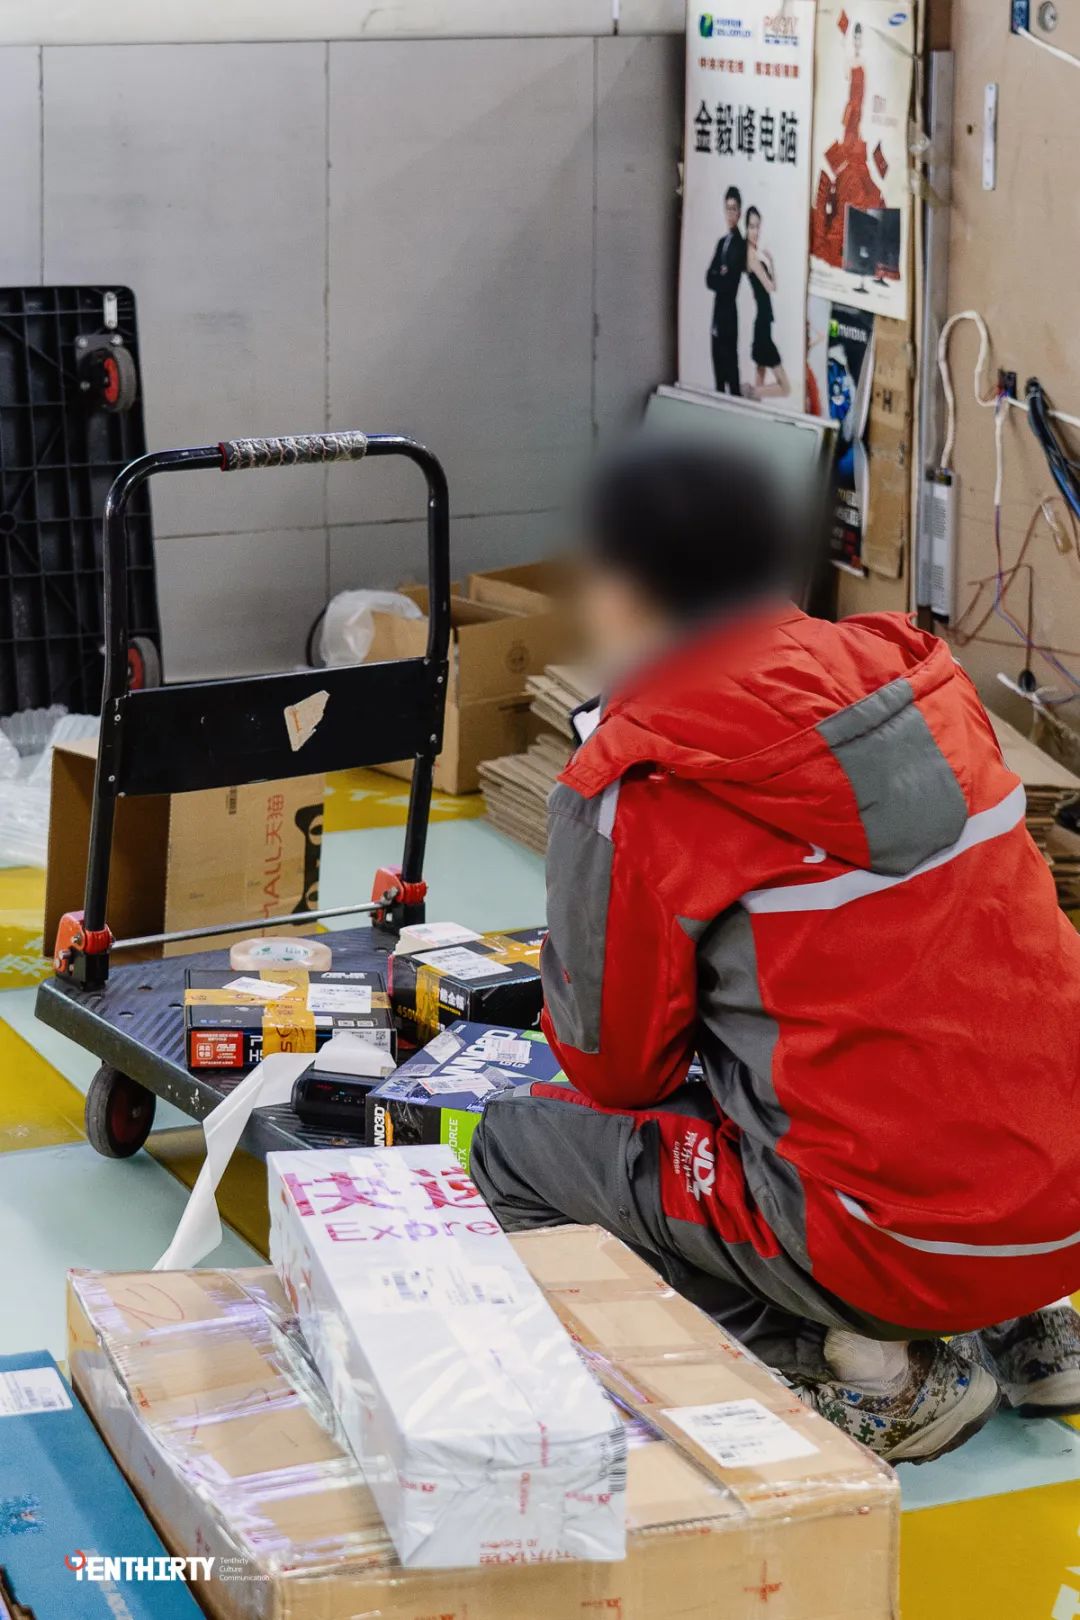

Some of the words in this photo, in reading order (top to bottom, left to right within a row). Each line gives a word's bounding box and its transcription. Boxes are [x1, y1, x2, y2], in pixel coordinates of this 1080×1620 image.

[694, 99, 799, 168] 金毅峰电脑
